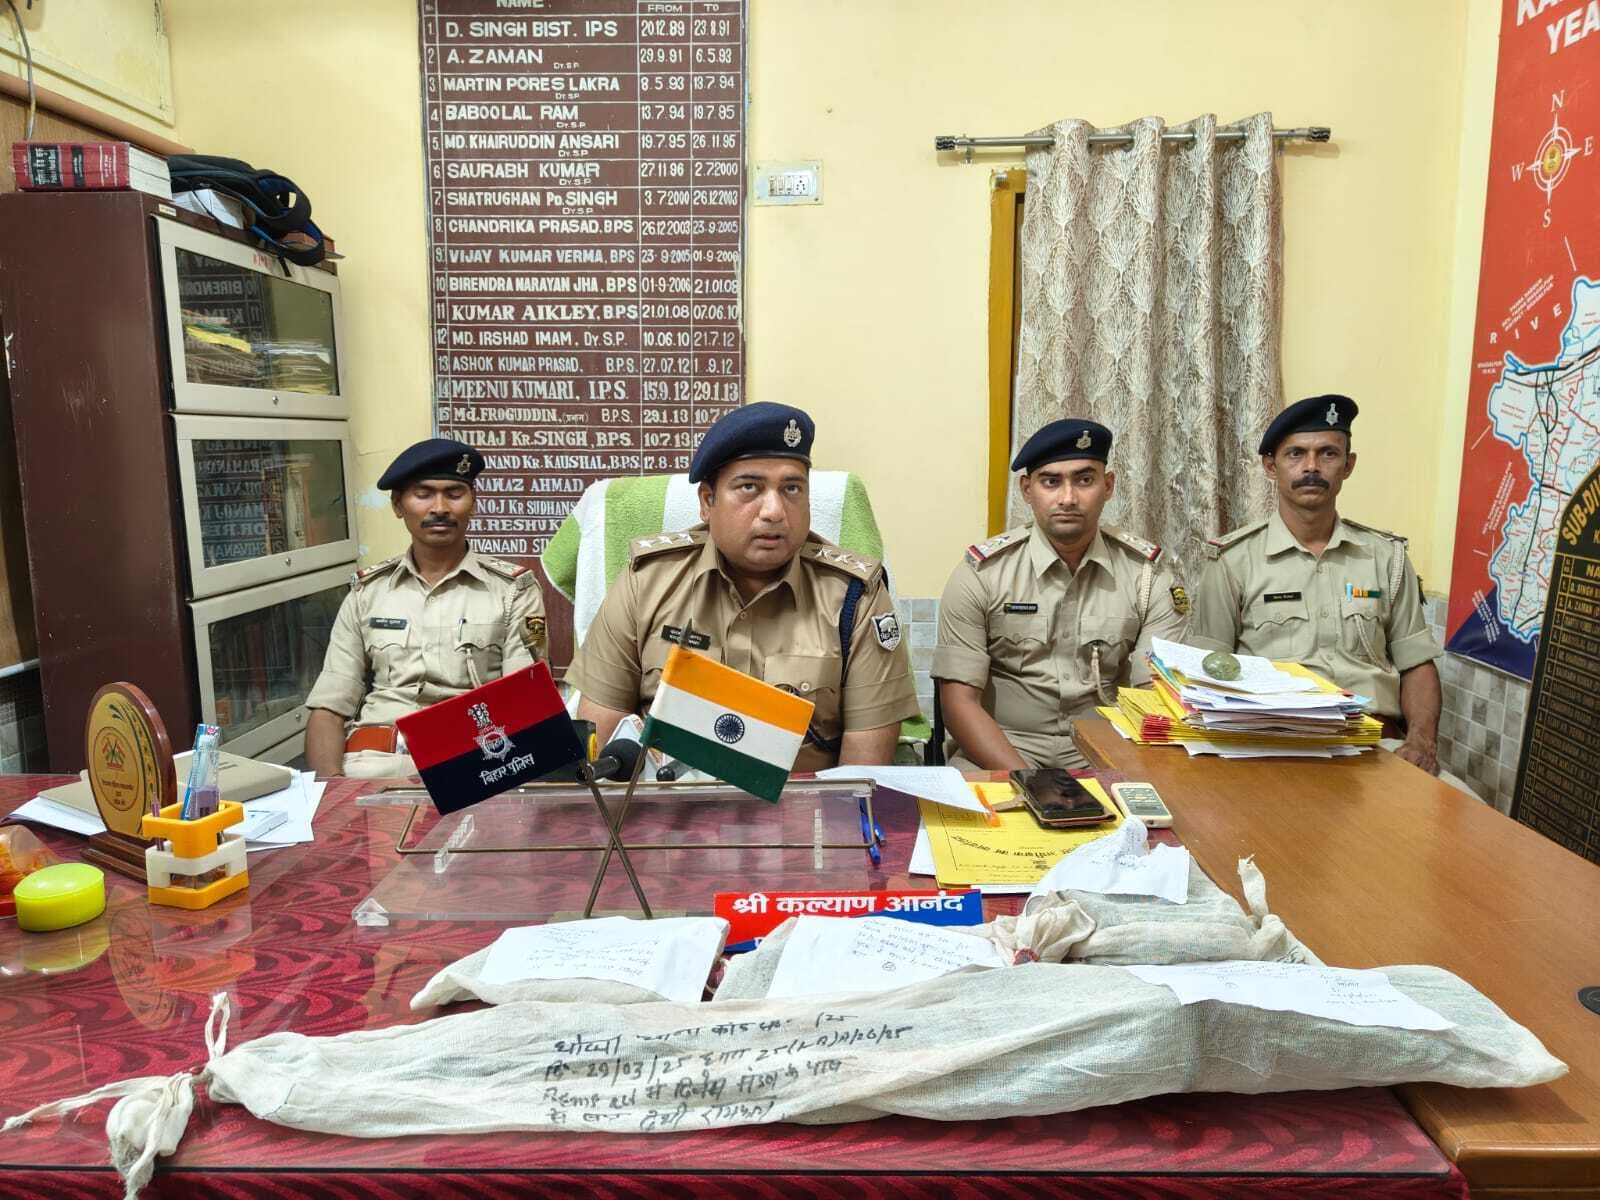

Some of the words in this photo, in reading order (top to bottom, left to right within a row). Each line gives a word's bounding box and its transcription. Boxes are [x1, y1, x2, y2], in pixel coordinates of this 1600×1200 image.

[647, 4, 683, 13] FROM
[703, 3, 720, 12] TO
[428, 22, 434, 36] 1
[445, 22, 463, 37] D.
[469, 21, 527, 37] SINGH
[585, 20, 618, 37] IPS
[427, 48, 434, 64] 2
[447, 49, 464, 64] A.
[468, 49, 543, 64] ZAMAN
[695, 48, 732, 64] 6.5.93
[444, 77, 501, 91] MARTIN
[506, 77, 565, 91] PORES
[569, 76, 620, 91] LAKRA
[1551, 89, 1565, 112] N
[540, 105, 579, 120] RAM
[641, 105, 685, 120] 13.7.94
[694, 104, 735, 120] 19.7.95
[559, 134, 619, 149] ANSARI
[641, 134, 686, 149] 19.7.95
[1511, 162, 1526, 183] W
[1584, 136, 1594, 156] E
[447, 163, 529, 179] SAURABH
[539, 162, 600, 178] KUMAR
[447, 191, 541, 206] SHATRUGHAN
[1542, 207, 1552, 228] S
[449, 219, 535, 233] CHANDRIKA
[450, 249, 492, 263] VIJAY
[500, 249, 552, 263] KUMAR
[610, 249, 635, 264] BPS
[436, 277, 445, 292] 10
[450, 277, 514, 292] BIRENDRA
[515, 277, 570, 292] NARAYAN
[606, 277, 637, 292] BPS
[437, 303, 445, 319] 11
[452, 305, 515, 320] KUMAR
[642, 304, 689, 319] 21.01.08
[693, 304, 738, 320] 07.06.10
[437, 329, 447, 344] 12
[452, 331, 476, 345] MD.
[479, 331, 528, 345] IRSHAD
[643, 331, 690, 346] 10.06.10
[694, 331, 735, 347] 21.7.12
[452, 357, 493, 372] ASHOK
[498, 357, 536, 372] KUMAR
[643, 357, 690, 373] 27.07.12
[452, 381, 508, 399] MEENU
[452, 430, 506, 446] NIRAJ
[531, 478, 584, 492] AHMAD
[476, 499, 505, 514] NOJ
[467, 538, 527, 554] IVANAND
[479, 766, 506, 785] बिहार
[506, 753, 535, 775] पुलिस
[732, 893, 769, 914] श्री
[776, 896, 877, 913] कल्याण
[884, 890, 966, 912] आनंद
